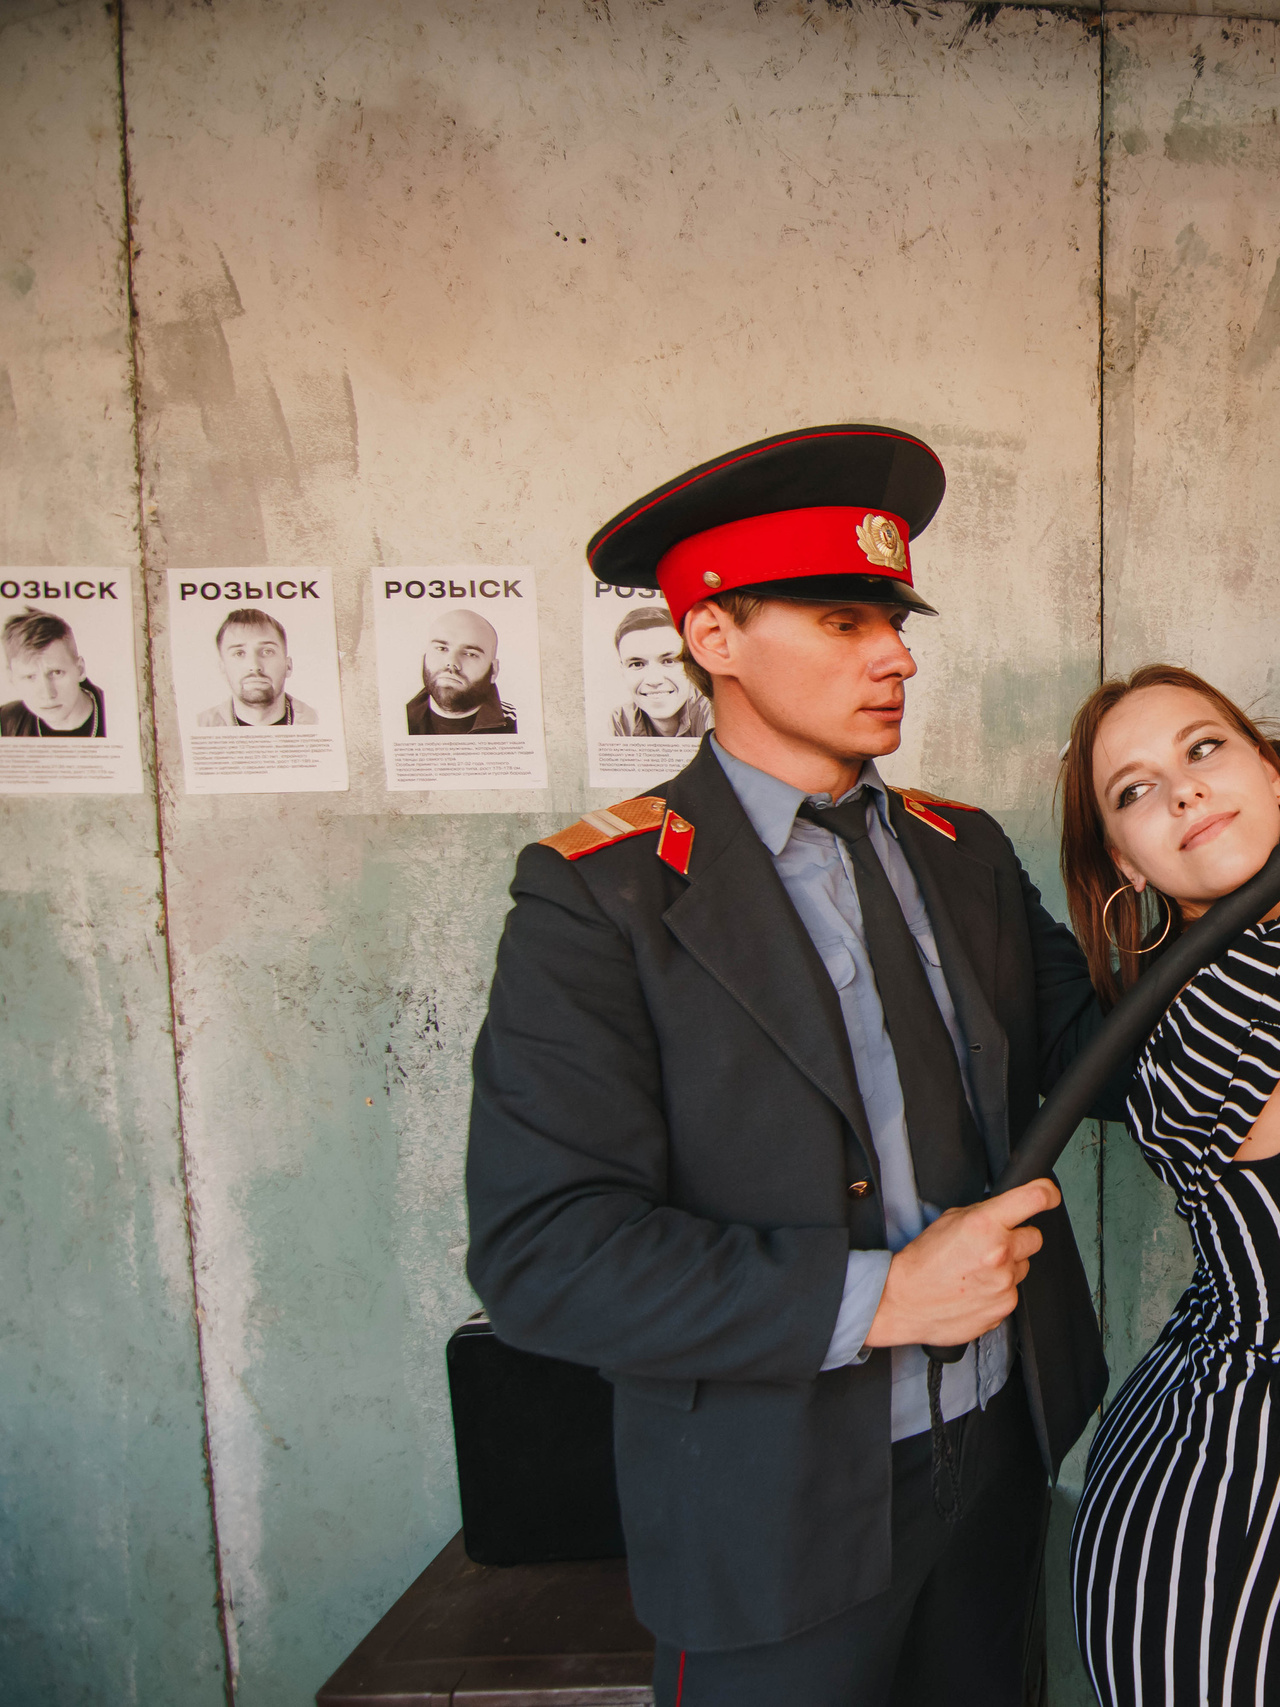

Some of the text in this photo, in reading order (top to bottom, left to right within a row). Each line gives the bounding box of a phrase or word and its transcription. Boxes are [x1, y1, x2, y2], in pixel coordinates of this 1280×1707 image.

[180, 580, 321, 601] РОЗЫСК
[385, 579, 523, 599] РОЗЫСК
[595, 581, 666, 599] РОЗ
